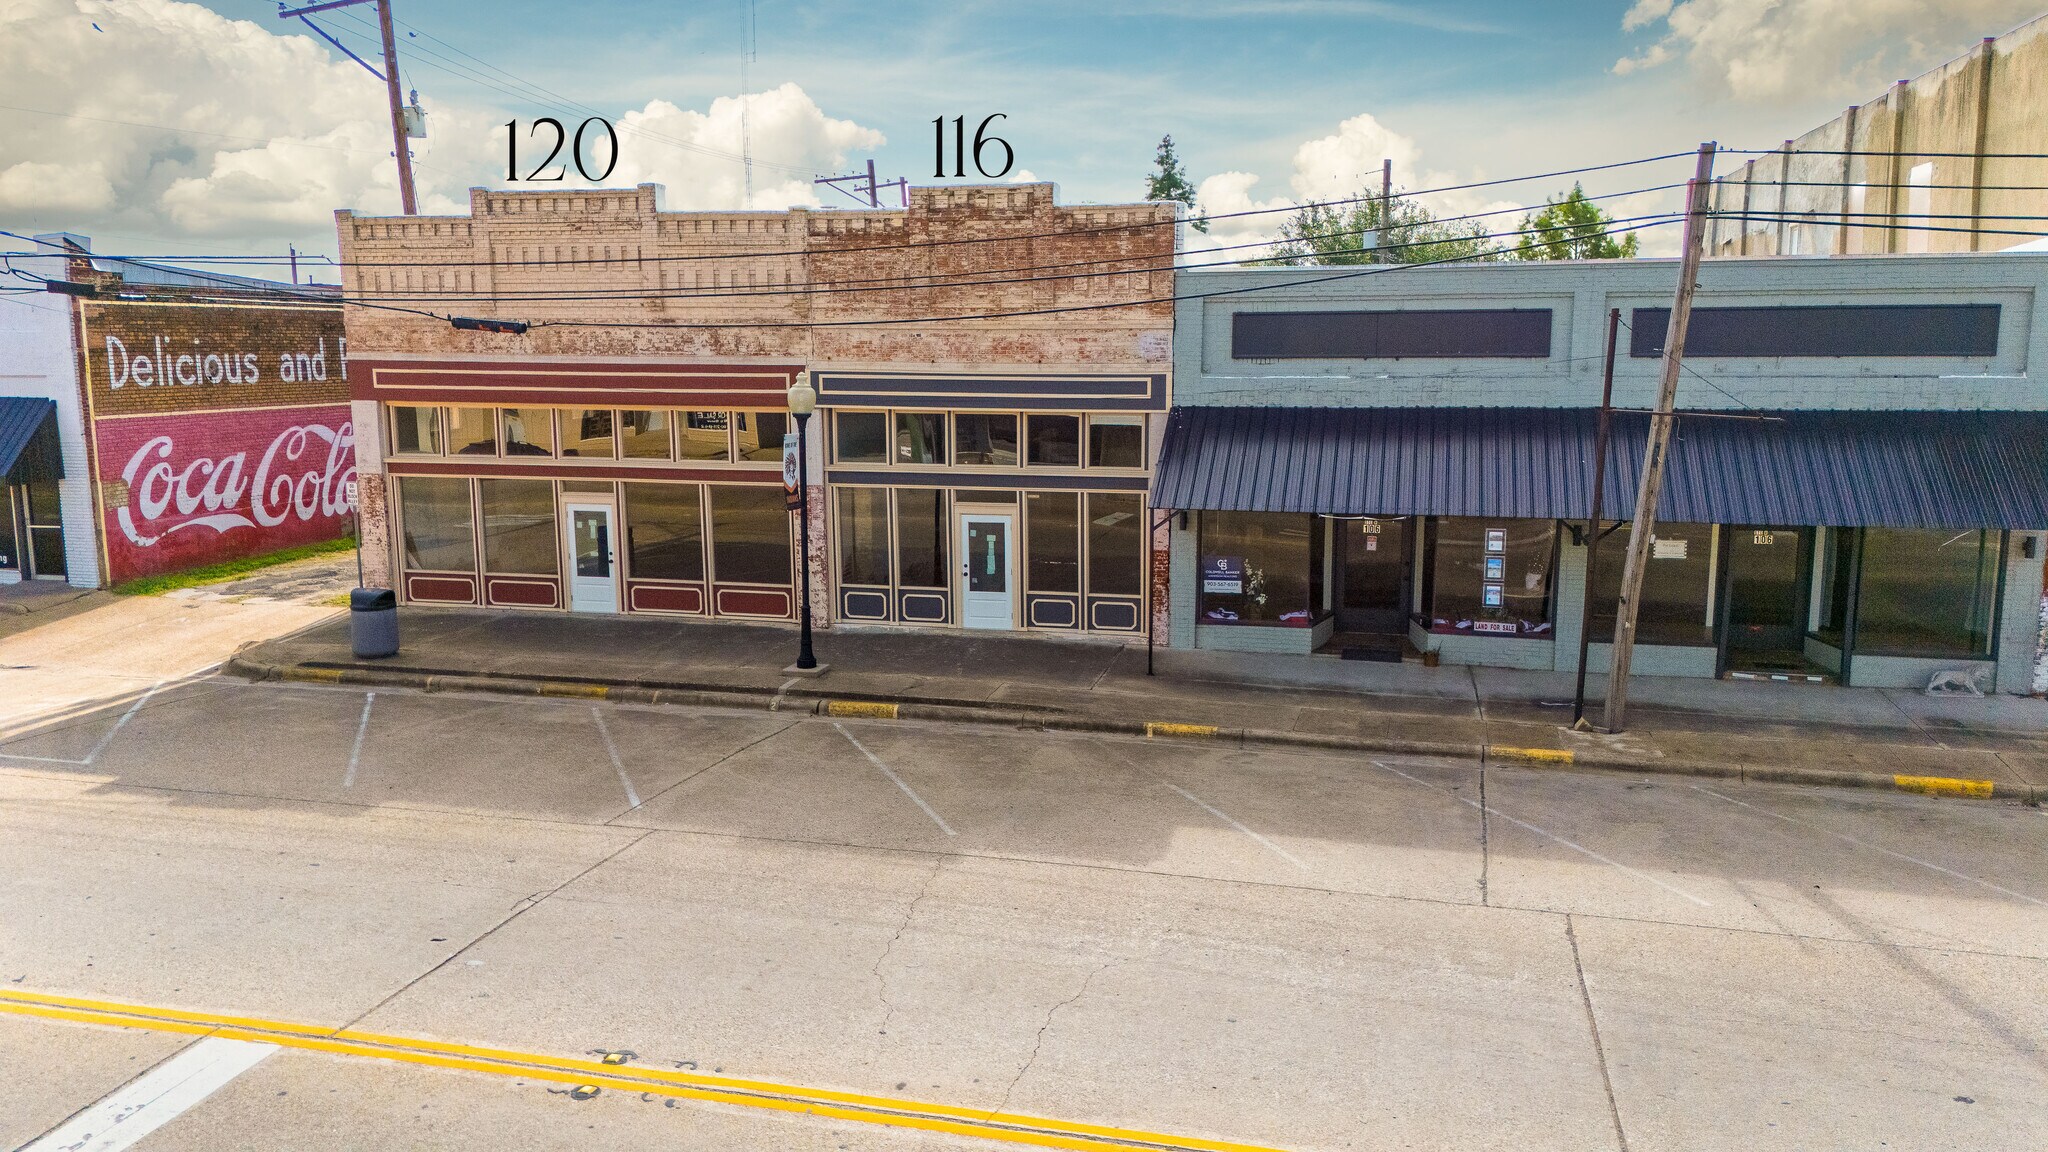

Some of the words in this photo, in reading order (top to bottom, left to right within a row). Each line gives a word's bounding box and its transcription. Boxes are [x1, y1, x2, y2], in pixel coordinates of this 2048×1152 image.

[106, 336, 260, 390] Delicious
[280, 337, 327, 382] and
[118, 436, 250, 546] Coca
[1364, 525, 1380, 533] 106
[1755, 535, 1772, 544] 106
[1475, 622, 1488, 630] LAND
[1490, 623, 1500, 631] FOR
[1502, 624, 1515, 632] SALE
